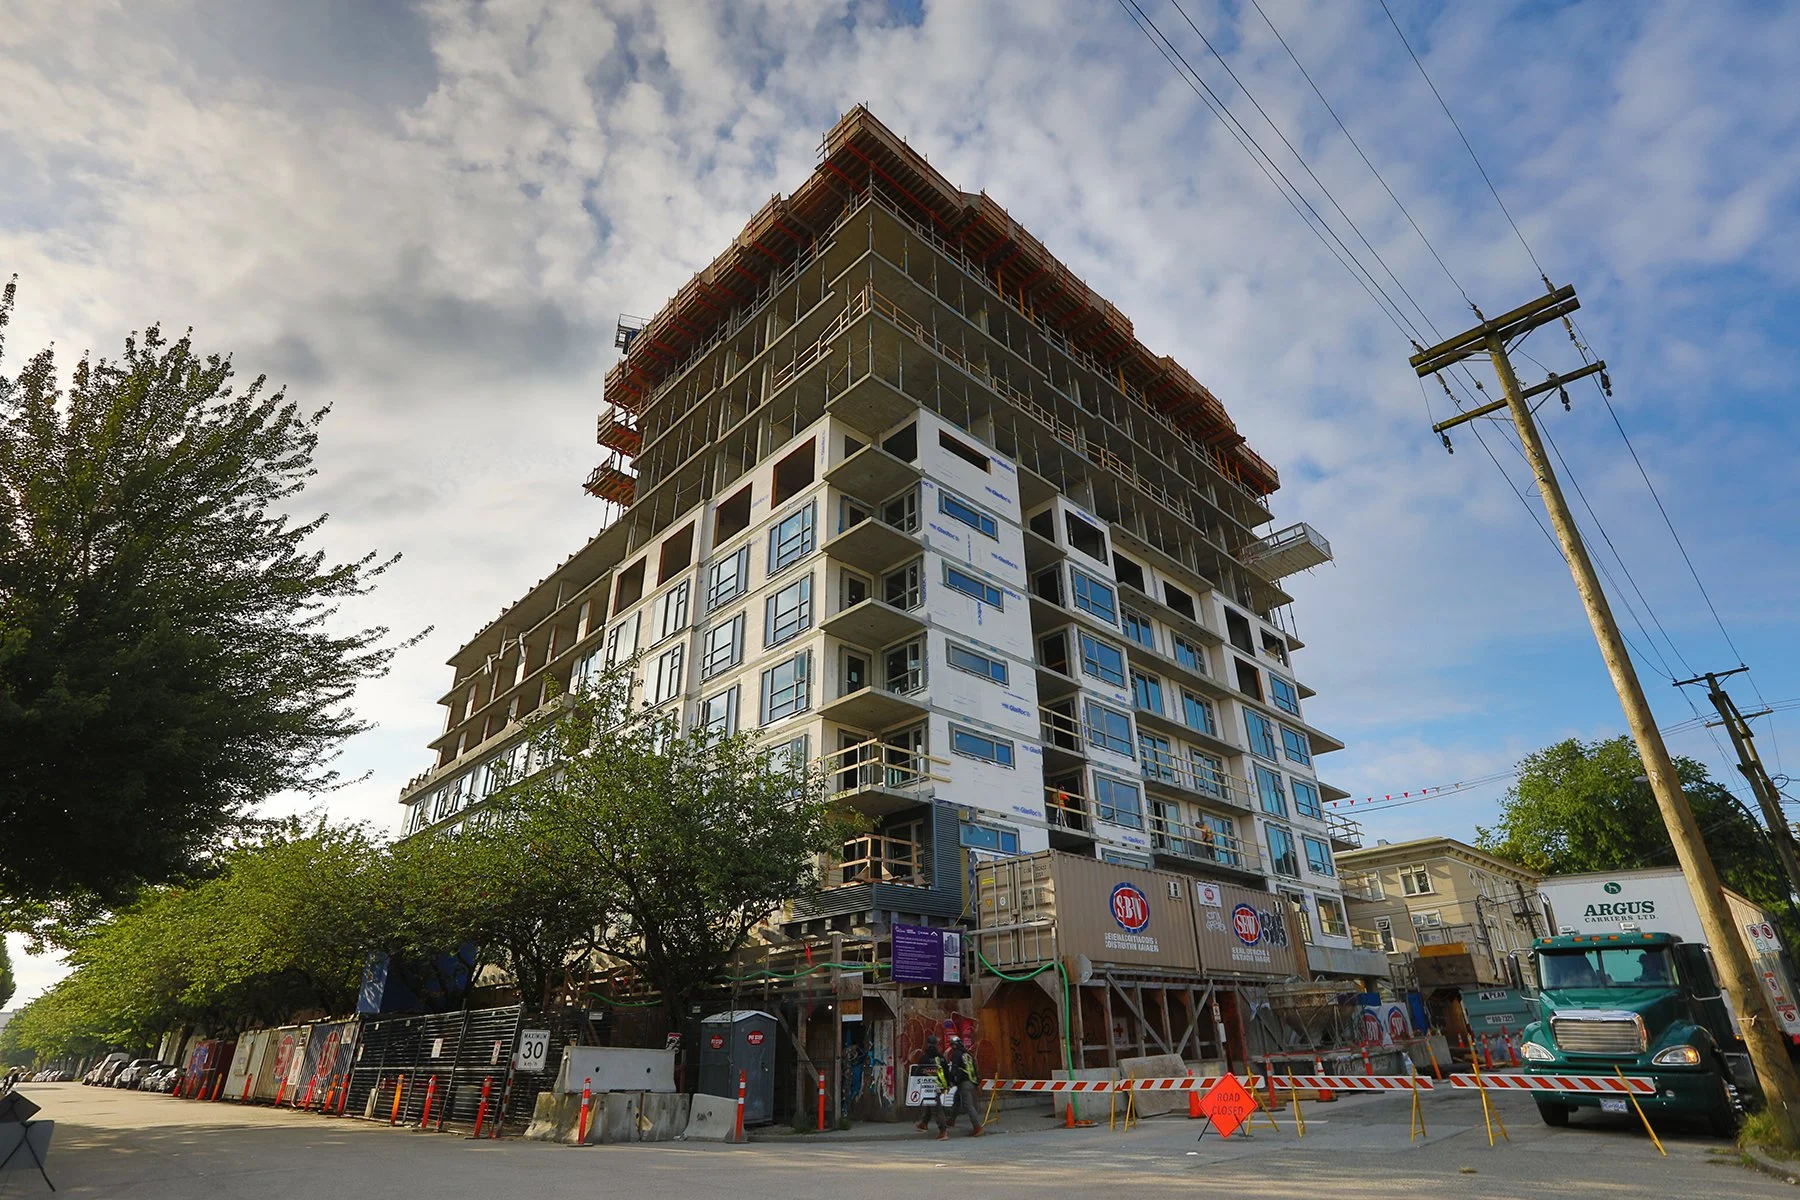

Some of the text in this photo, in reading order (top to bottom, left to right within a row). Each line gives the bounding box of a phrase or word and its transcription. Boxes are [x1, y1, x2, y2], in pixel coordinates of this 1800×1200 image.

[1584, 901, 1655, 917] ARGUS
[1584, 915, 1634, 923] CARRIERS
[1490, 991, 1506, 999] PEAK
[522, 1041, 543, 1059] 30
[1217, 1093, 1240, 1102] ROAD
[1211, 1105, 1244, 1116] CLOSED
